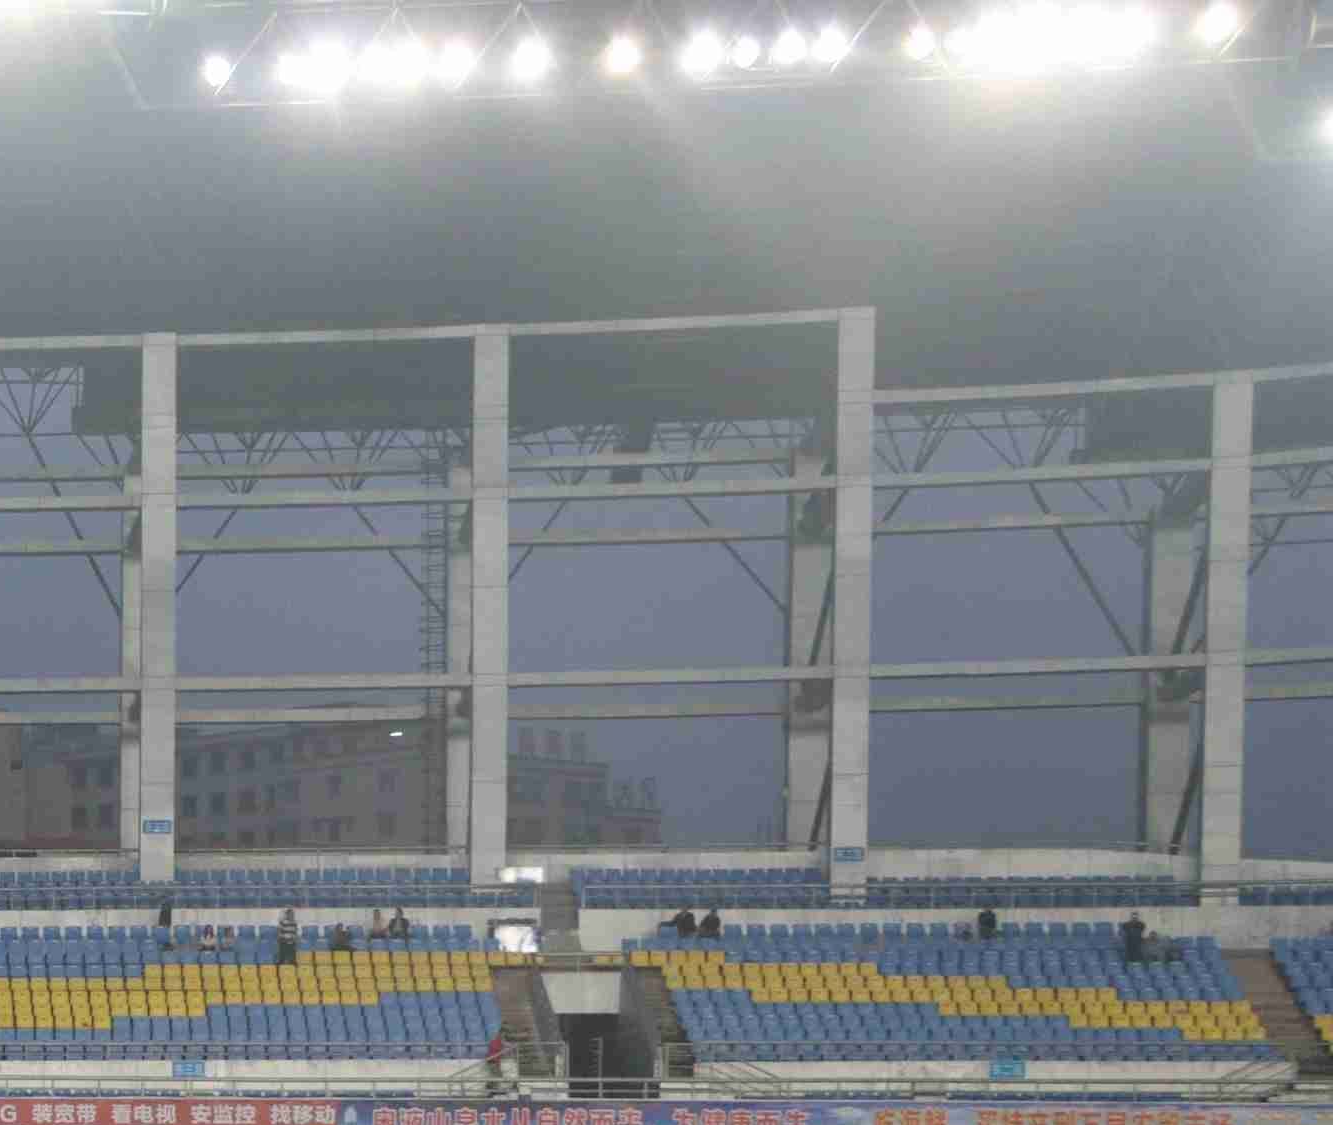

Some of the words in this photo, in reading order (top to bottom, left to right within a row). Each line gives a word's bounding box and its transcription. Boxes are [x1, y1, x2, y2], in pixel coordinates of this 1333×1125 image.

[32, 1103, 97, 1123] 装宽带
[111, 1103, 177, 1124] 看电视
[190, 1104, 257, 1124] 安监控
